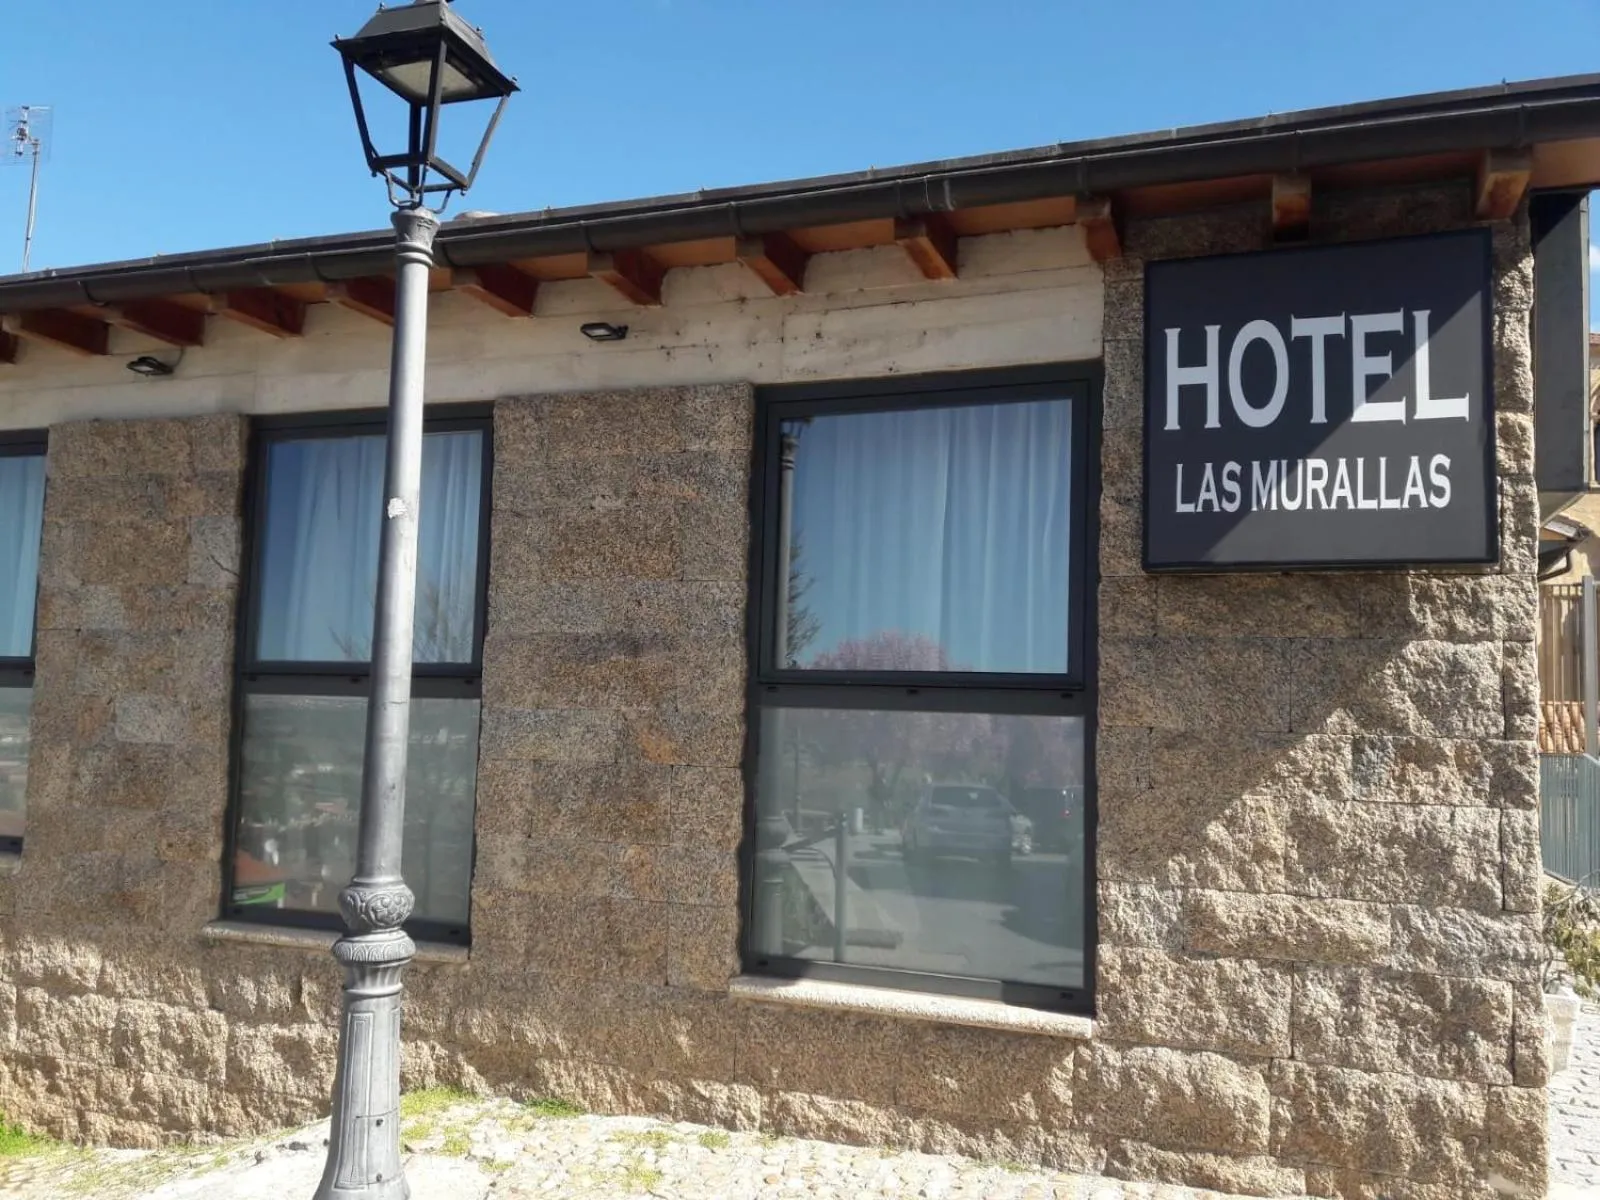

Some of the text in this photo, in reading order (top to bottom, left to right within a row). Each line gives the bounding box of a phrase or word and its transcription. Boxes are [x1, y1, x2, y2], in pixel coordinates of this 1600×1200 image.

[1164, 308, 1469, 430] HOTEL
[1175, 453, 1452, 513] LAS MURALLAS
